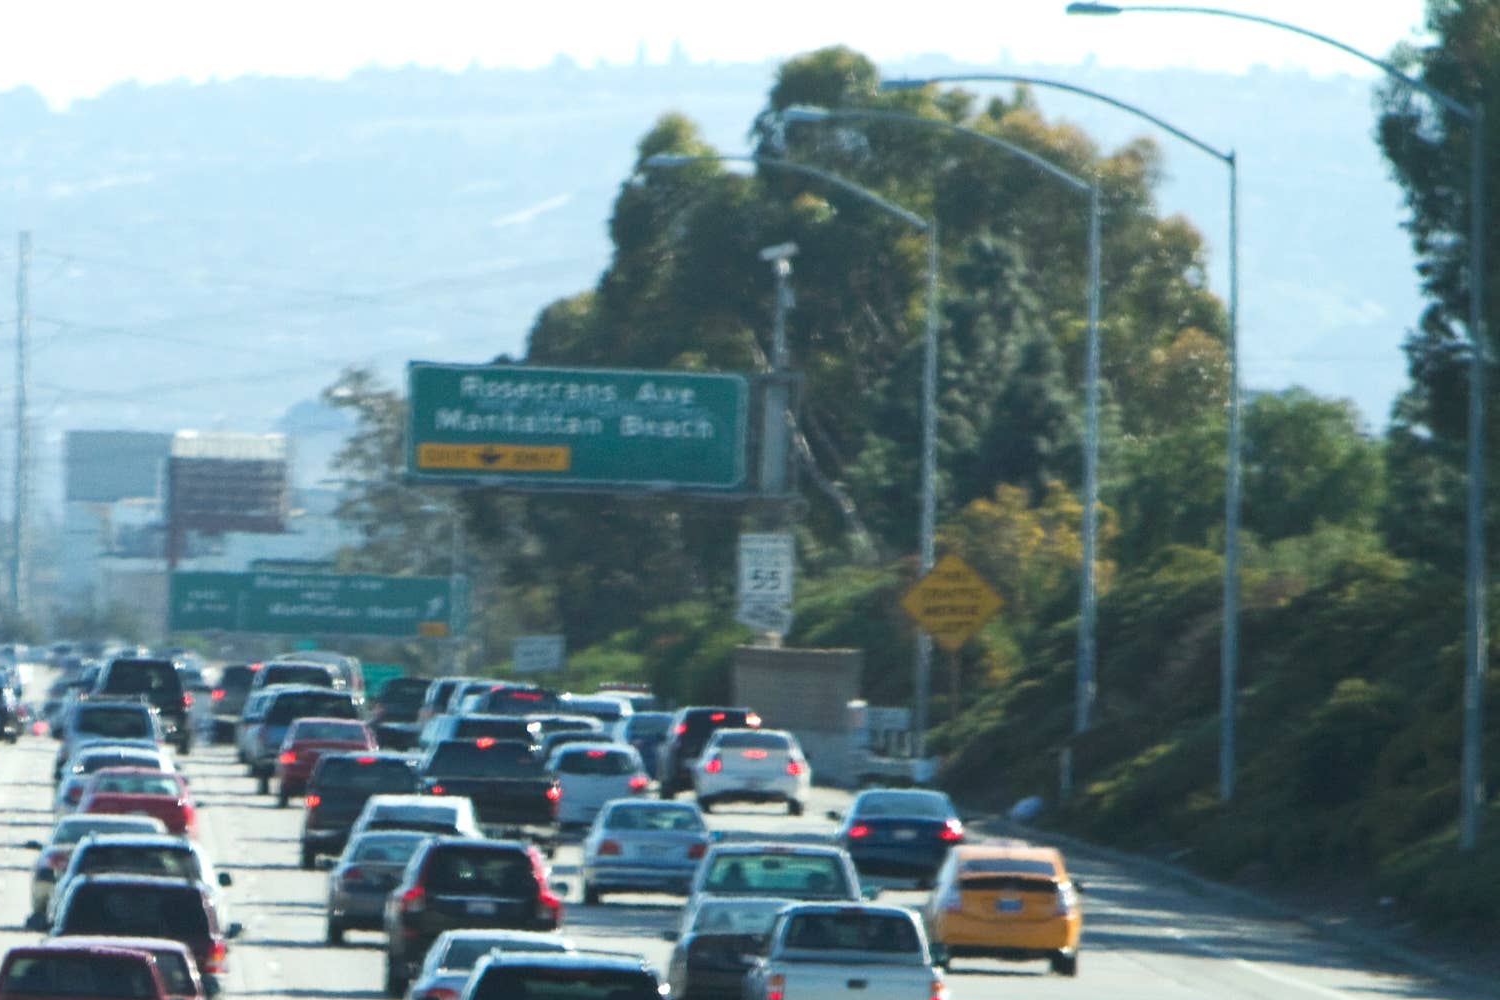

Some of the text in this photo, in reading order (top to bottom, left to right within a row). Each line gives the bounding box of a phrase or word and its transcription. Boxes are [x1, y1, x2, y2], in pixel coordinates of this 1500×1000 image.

[460, 375, 618, 402] Rosecrans
[435, 407, 714, 439] Manhattan Beach
